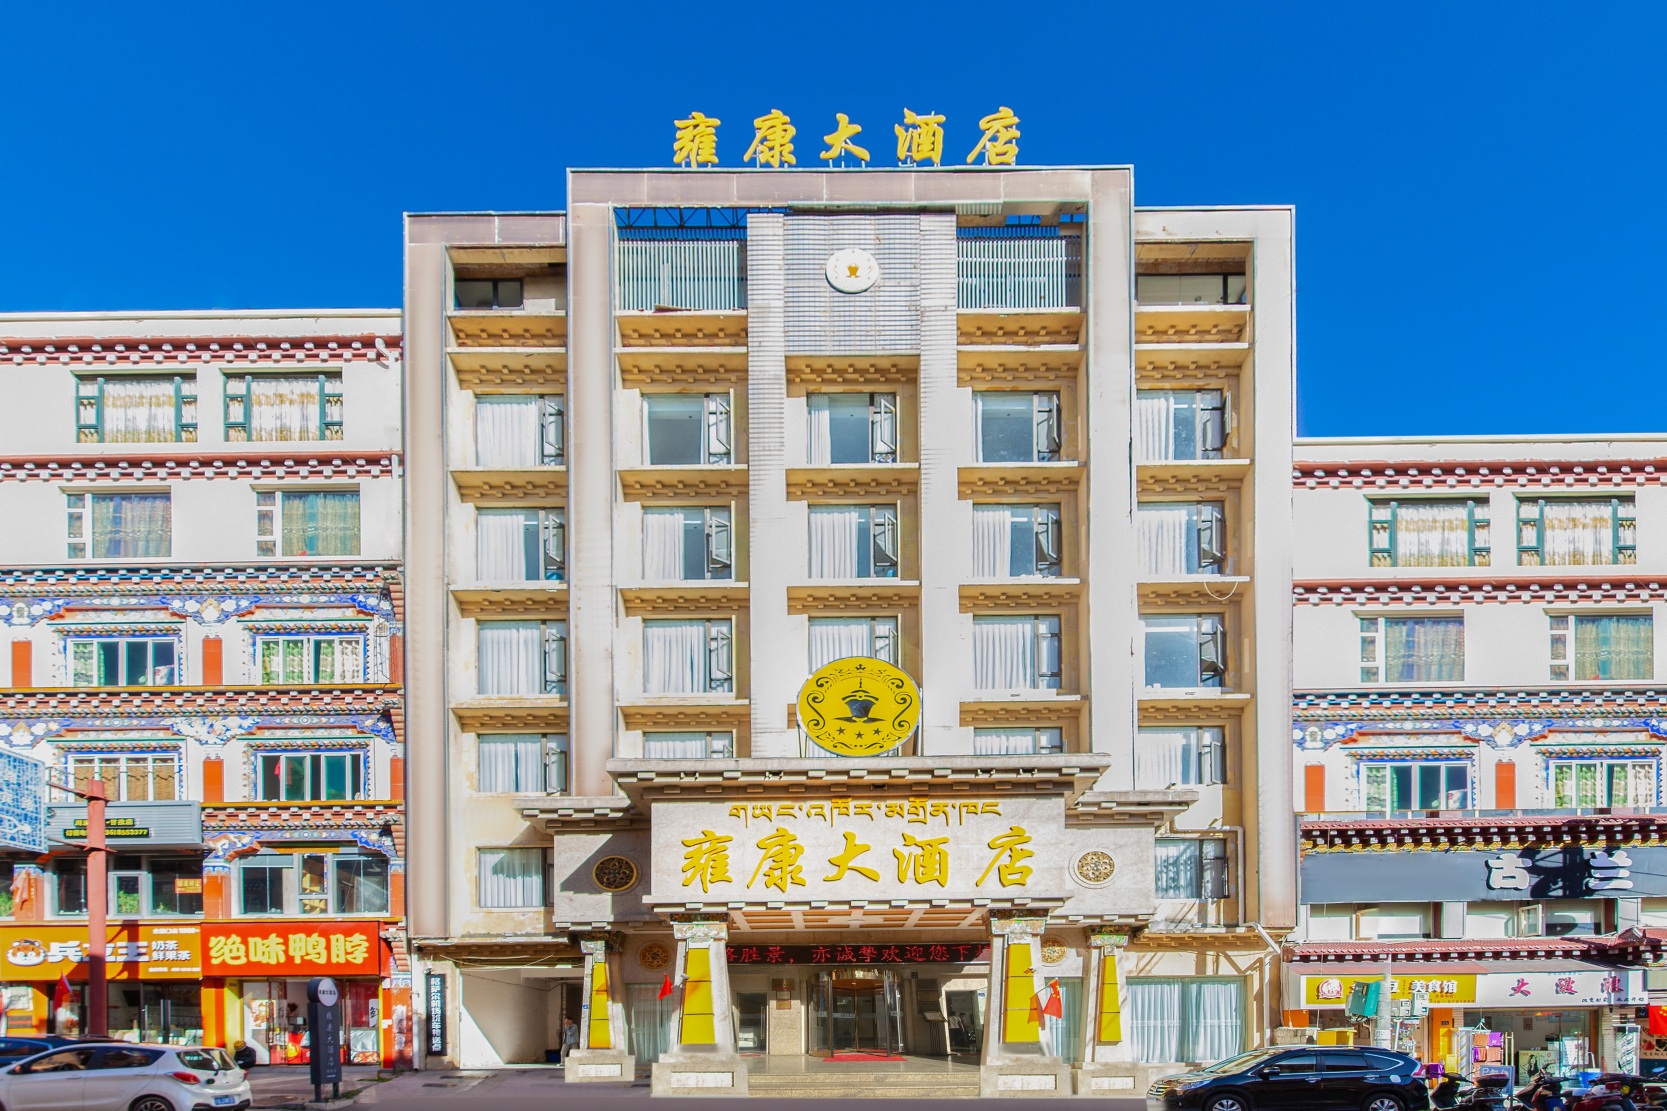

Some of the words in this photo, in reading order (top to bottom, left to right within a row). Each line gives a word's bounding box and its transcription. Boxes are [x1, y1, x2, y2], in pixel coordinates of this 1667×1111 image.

[673, 106, 1021, 169] 雍康大酒店
[680, 825, 1036, 893] 雍康大酒店
[151, 940, 178, 950] 奶茶
[152, 950, 191, 961] 鲜果茶
[208, 933, 369, 966] 绝味鸭脖
[1409, 979, 1458, 994] 美食馆
[1508, 976, 1624, 997] 大波浪
